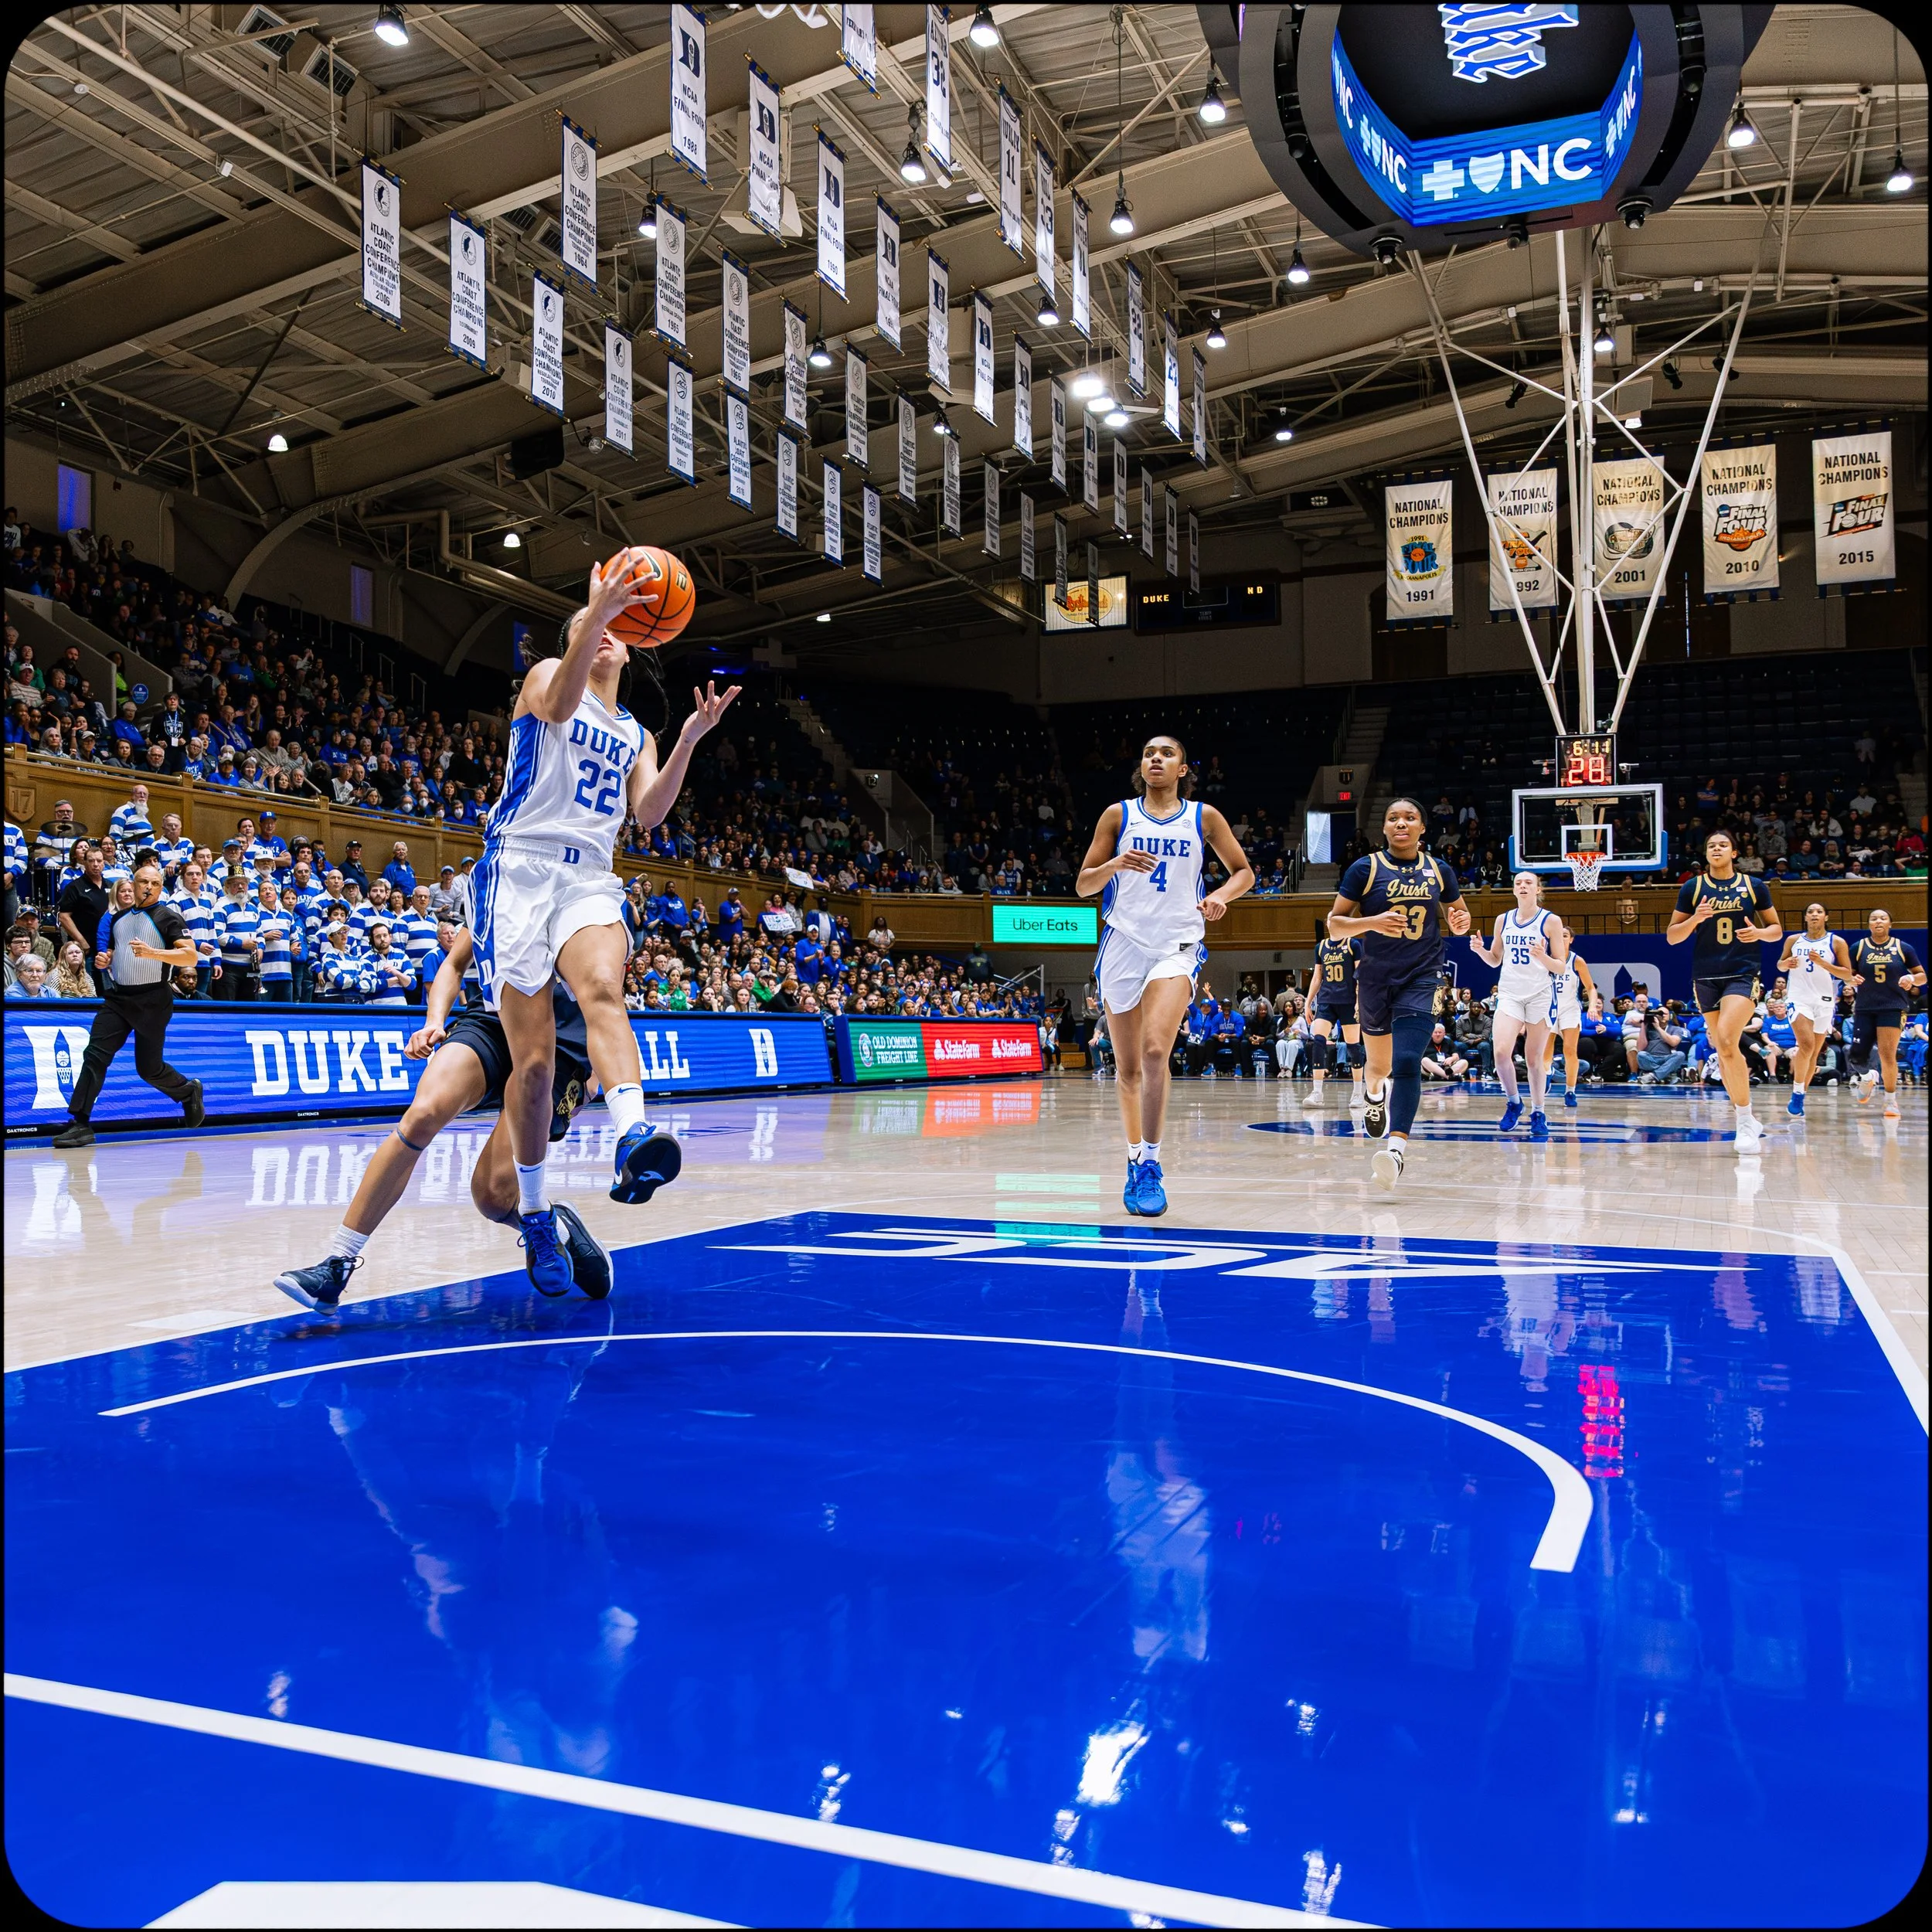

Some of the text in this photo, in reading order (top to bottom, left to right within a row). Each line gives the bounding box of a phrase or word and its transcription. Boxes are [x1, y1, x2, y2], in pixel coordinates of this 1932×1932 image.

[682, 83, 698, 106] NCAA
[674, 96, 692, 121] FINAL
[683, 136, 698, 155] 1988
[759, 150, 774, 171] NCAA
[1006, 148, 1016, 185] 11
[1382, 142, 1406, 193] NC
[1510, 138, 1593, 190] NC
[570, 183, 591, 208] ATLANTIC
[573, 198, 588, 218] COAST
[565, 204, 596, 236] CONFERENCE
[827, 214, 837, 233] NCAA
[371, 221, 395, 246] ATLANTIC
[566, 218, 594, 247] CHAMPIONS
[821, 226, 832, 245] FINAL
[374, 236, 391, 255] COAST
[366, 243, 400, 273] CONFERENCE
[574, 251, 587, 269] 1964
[662, 257, 681, 277] ATLANTIC
[828, 259, 838, 276] 1990
[367, 257, 399, 284] CHAMPIONS
[665, 270, 679, 286] COAST
[457, 270, 480, 292] ATLANTIC
[658, 277, 685, 303] CONFERENCE
[376, 290, 390, 307] 2006
[461, 284, 478, 301] COAST
[659, 288, 684, 314] CHAMPIONS
[452, 291, 484, 318] CONFERENCE
[453, 304, 483, 328] CHAMPIONS
[728, 308, 745, 328] ATLANTIC
[459, 320, 478, 335] TOURNAMENT
[538, 326, 559, 347] ATLANTIC
[730, 321, 743, 337] COAST
[462, 333, 476, 349] 2009
[543, 339, 556, 355] COAST
[725, 328, 750, 351] CONFERENCE
[534, 345, 563, 371] CONFERENCE
[726, 340, 749, 362] CHAMPIONS
[536, 358, 562, 381] CHAMPIONS
[611, 372, 629, 390] ATLANTIC
[786, 371, 807, 390] CONFEREN
[542, 385, 556, 400] 2010
[613, 385, 626, 398] COAST
[607, 391, 634, 413] CONFERENCE
[609, 403, 633, 423] CHAMPIONS
[675, 405, 690, 422] ATLANTIC
[670, 423, 692, 441] CONFERENCE
[675, 416, 687, 430] COAST
[615, 429, 627, 441] 2011
[672, 433, 692, 451] CHAMPIONS
[676, 457, 686, 469] 2017
[1825, 451, 1881, 468] NATIONAL
[1712, 464, 1766, 481] NATIONAL
[1818, 466, 1888, 485] CHAMPIONS
[1603, 474, 1655, 491] NATIONAL
[1706, 478, 1773, 497] CHAMPIONS
[1395, 498, 1443, 514] NATIONAL
[1597, 489, 1661, 506] CHAMPIONS
[1847, 496, 1885, 514] FINAL
[1493, 501, 1554, 518] HAMPIONS
[1730, 507, 1765, 519] FINAL
[1389, 512, 1448, 529] CHAMPIONS
[1715, 517, 1767, 536] FOUR
[1509, 546, 1542, 556] FOU
[1838, 550, 1874, 565] 2015
[1614, 570, 1646, 583] 2001
[1726, 560, 1759, 574] 2010
[1516, 580, 1539, 592] 992
[1143, 594, 1169, 604] DUKE
[1406, 590, 1434, 602] 1991
[570, 718, 636, 777] DUKE
[1573, 740, 1610, 756] 6:11
[1568, 757, 1605, 784] 28
[574, 759, 621, 817] 22
[12, 790, 32, 814] 17
[1132, 837, 1191, 857] DUKE
[1149, 861, 1167, 892] 4
[1386, 879, 1432, 902] Irish
[1709, 896, 1743, 912] Irish
[1012, 918, 1078, 931] Uber Eats
[1384, 905, 1427, 940] 23
[1716, 917, 1733, 944] 8
[1505, 935, 1536, 946] DUKE
[1323, 951, 1345, 964] Irish
[1511, 947, 1530, 965] 35
[1805, 959, 1814, 972] 3
[1866, 952, 1893, 964] Irish
[1325, 964, 1344, 982] 30
[1874, 964, 1886, 983] 5
[872, 1036, 918, 1049] OLD DOMINION
[245, 1030, 410, 1096] DUKE
[876, 1050, 919, 1063] FREIGHT LINE
